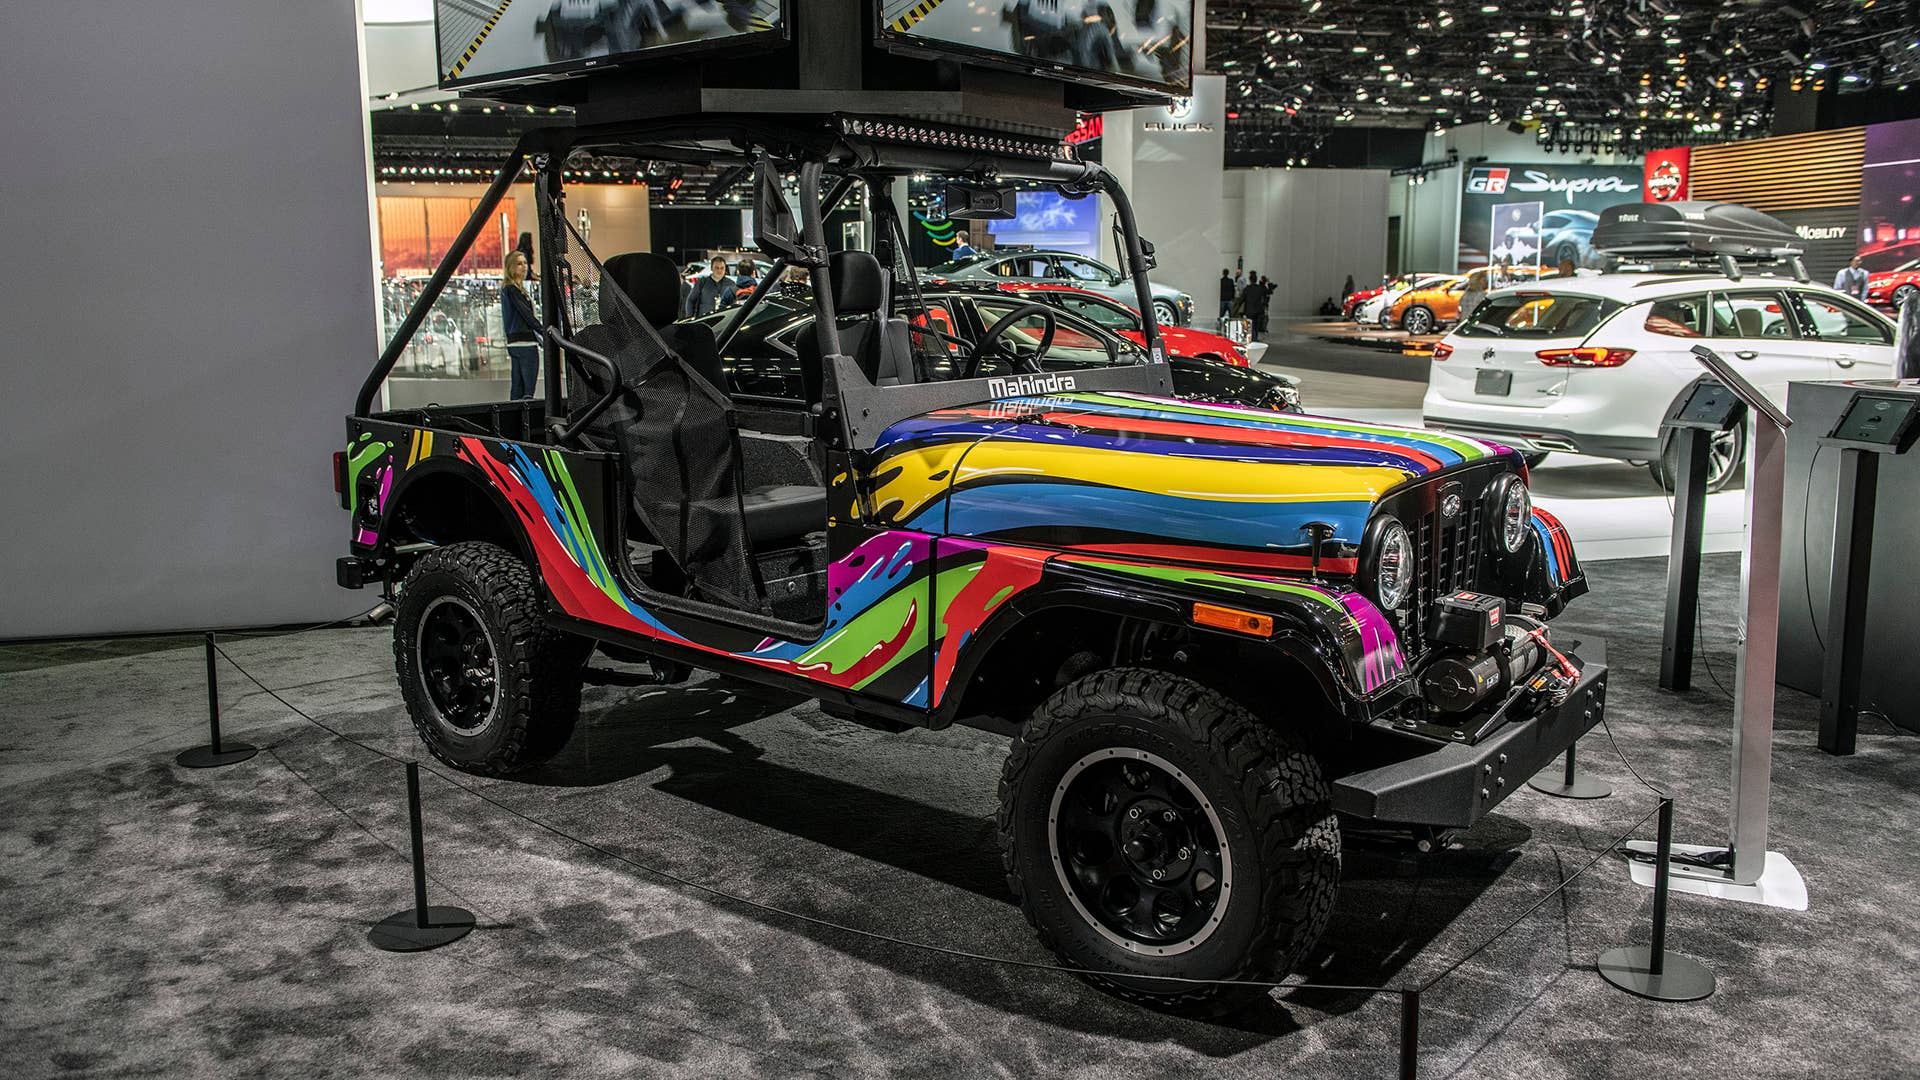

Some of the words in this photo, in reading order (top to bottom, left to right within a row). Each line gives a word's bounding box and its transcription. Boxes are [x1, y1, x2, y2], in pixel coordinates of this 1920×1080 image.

[1143, 121, 1216, 133] BUICK
[1468, 175, 1506, 194] GR
[1510, 169, 1639, 205] Supra
[988, 373, 1076, 399] Mahindra
